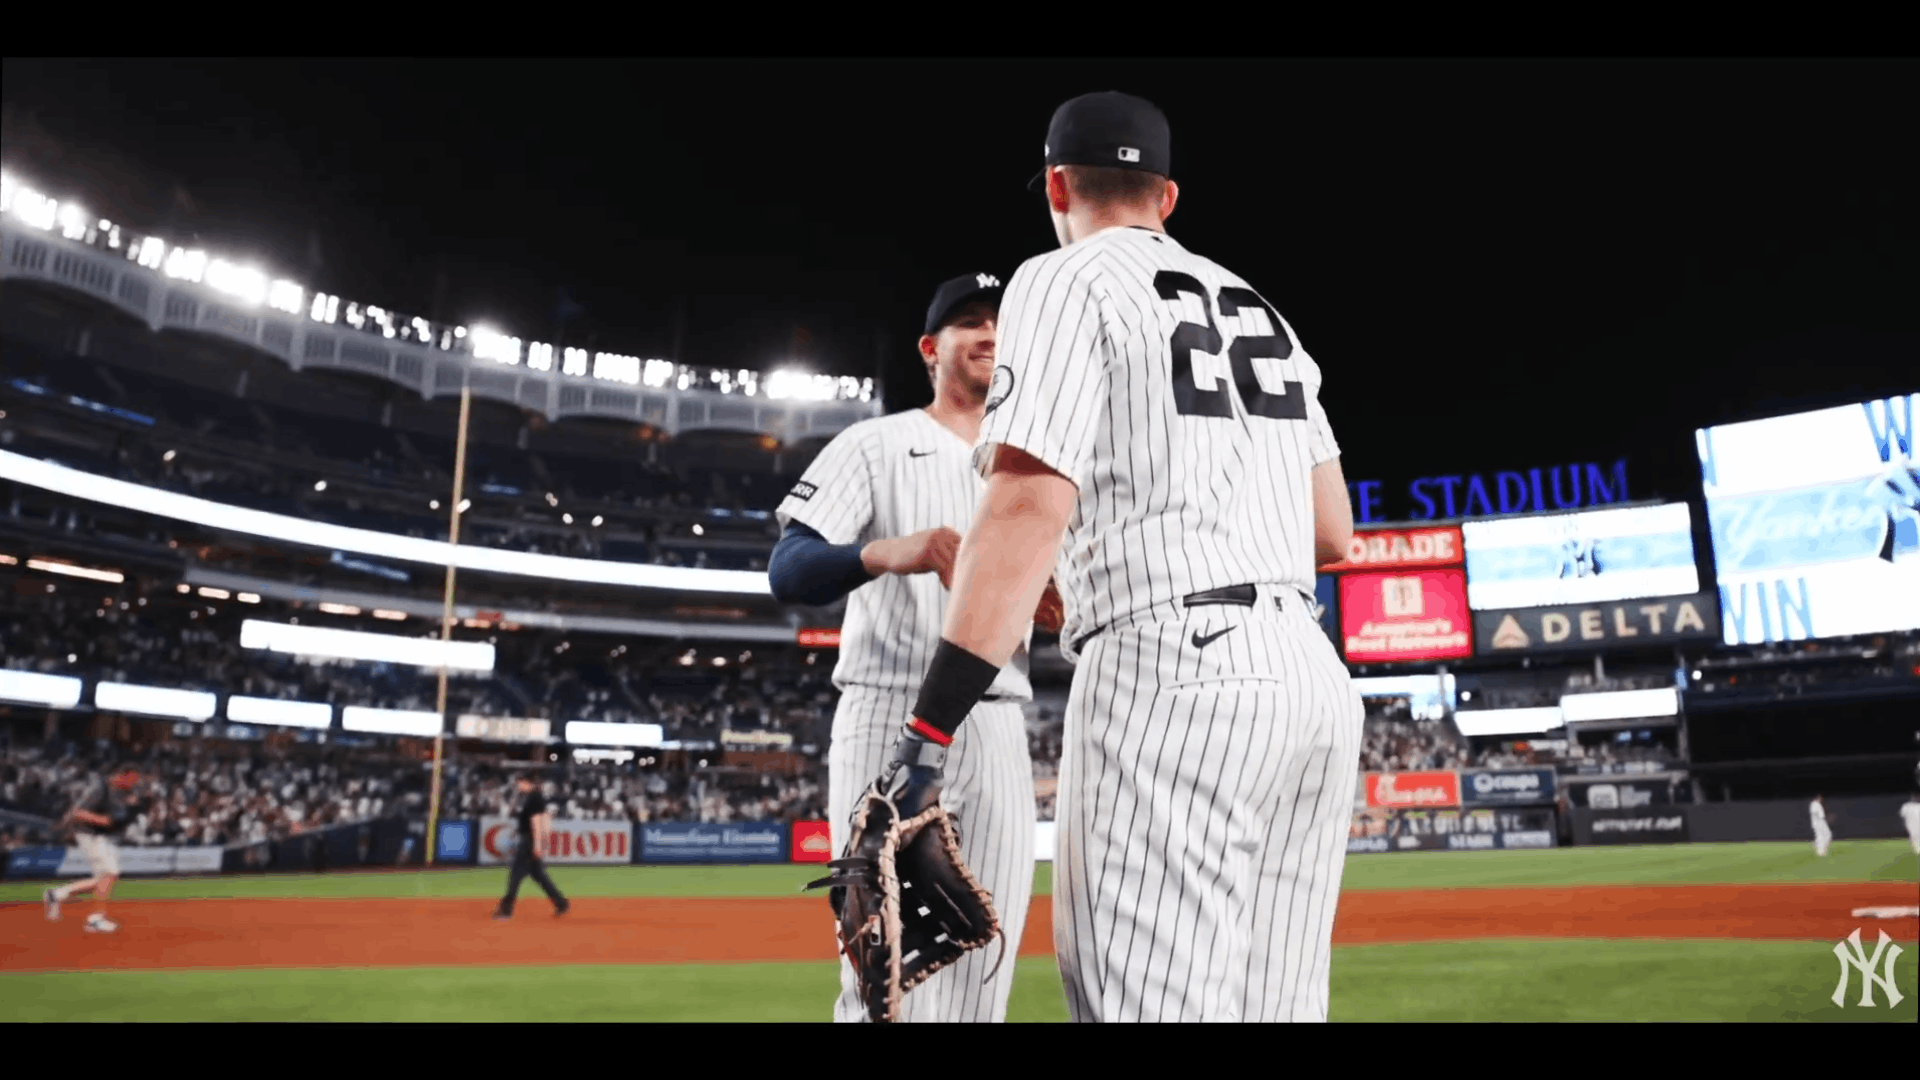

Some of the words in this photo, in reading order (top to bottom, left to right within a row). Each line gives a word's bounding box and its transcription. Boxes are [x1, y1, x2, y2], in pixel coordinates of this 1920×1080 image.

[1153, 270, 1307, 420] 22
[1409, 459, 1629, 521] STADIUM
[1541, 602, 1705, 643] DELTA
[483, 823, 628, 859] Cnon
